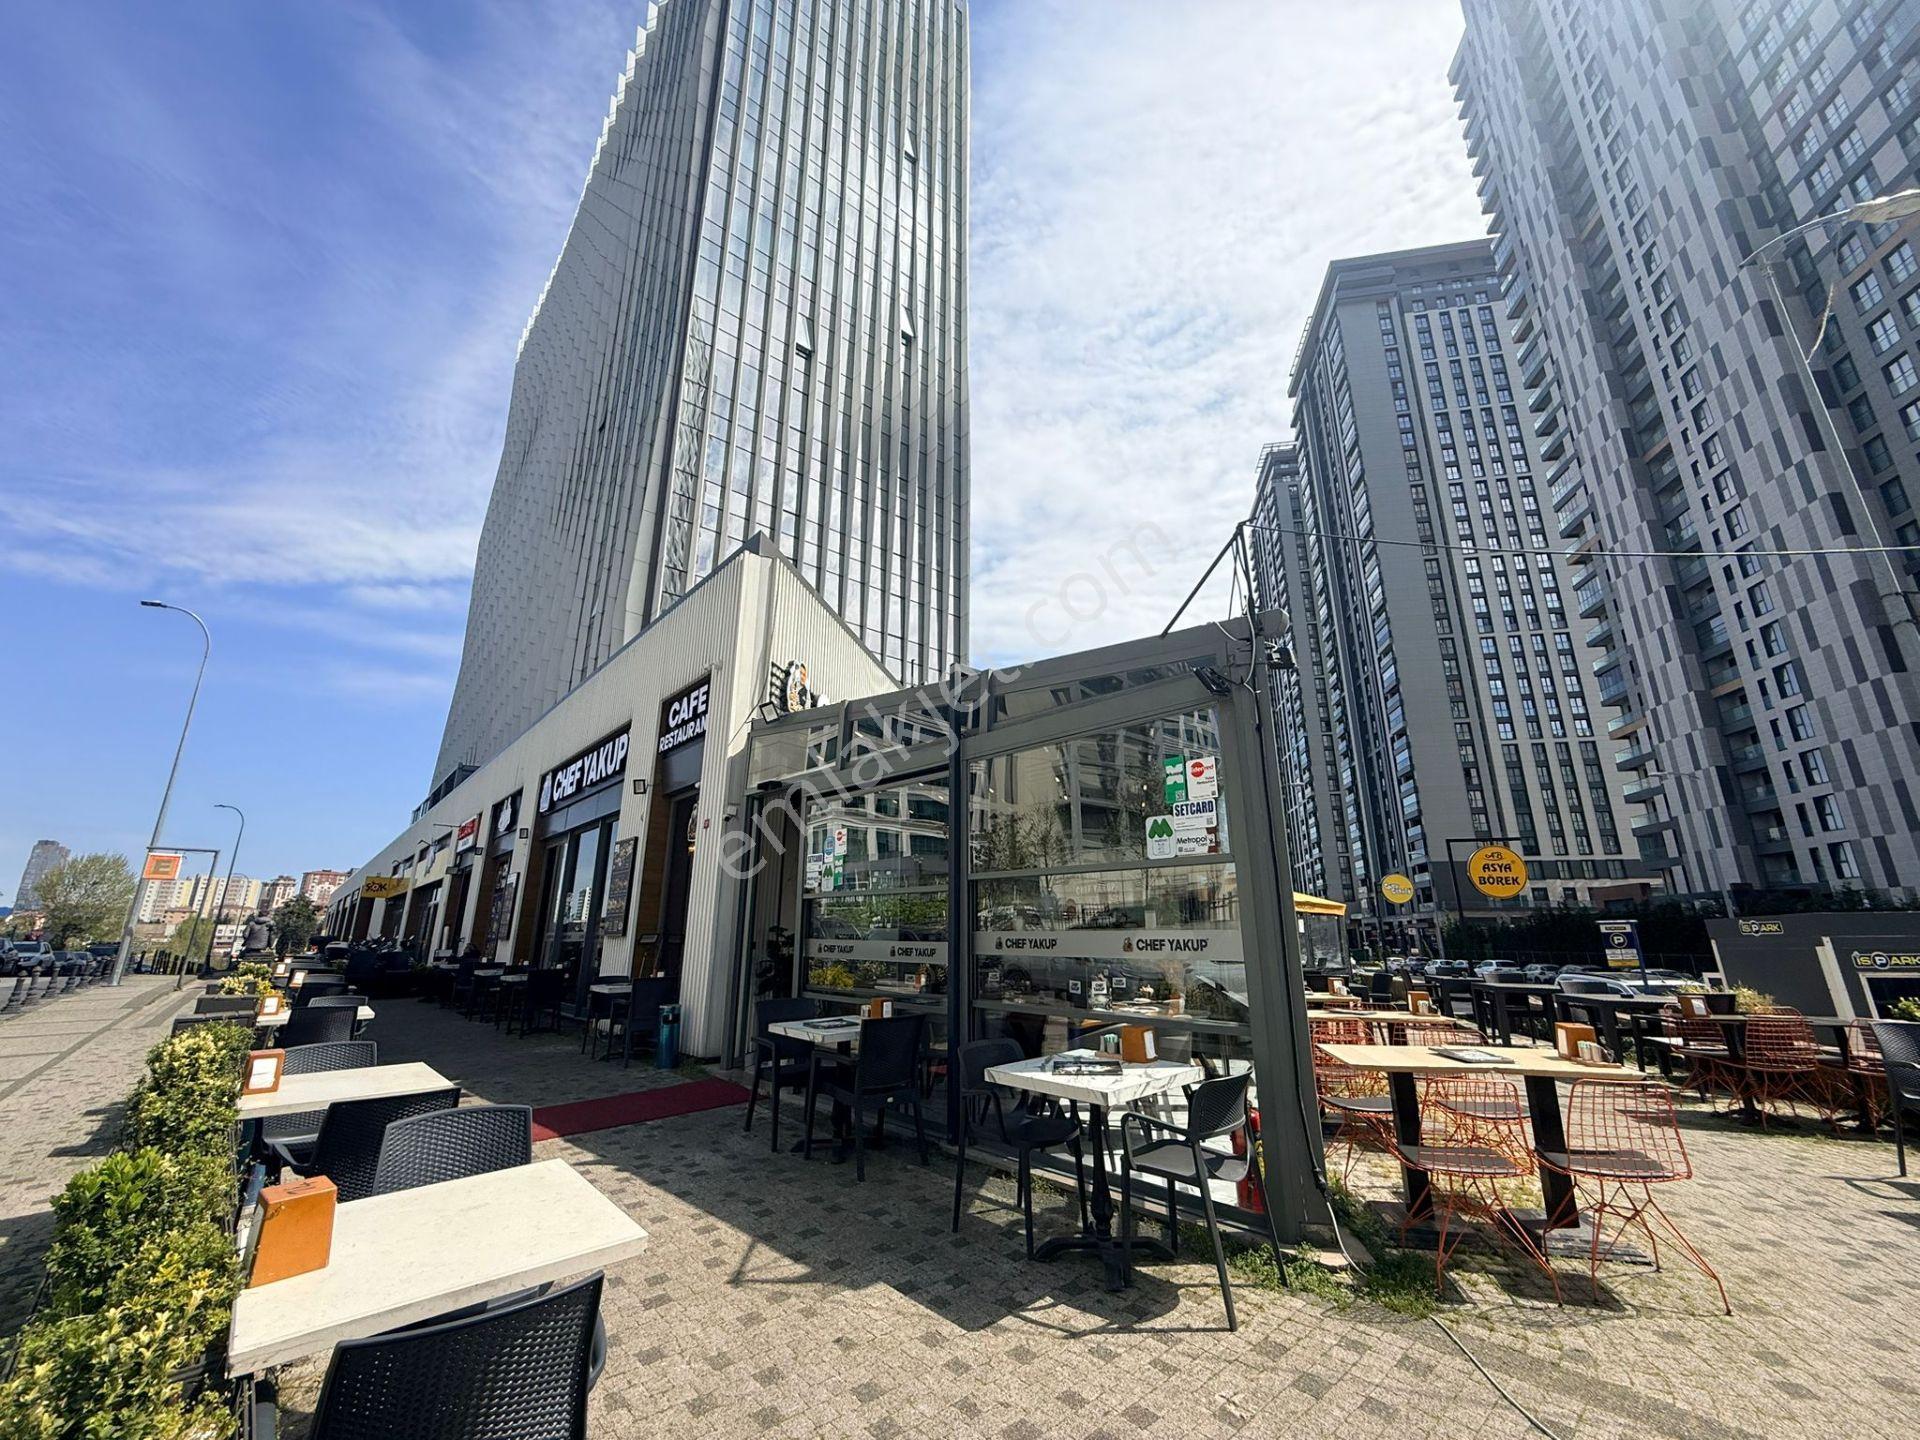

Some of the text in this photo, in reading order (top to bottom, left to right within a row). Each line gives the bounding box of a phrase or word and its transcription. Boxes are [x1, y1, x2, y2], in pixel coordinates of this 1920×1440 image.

[668, 684, 709, 728] CAFE
[553, 733, 630, 801] CHEF YAKUP
[1174, 800, 1214, 817] SETCARD
[1176, 835, 1208, 845] Metropol
[1482, 863, 1512, 873] ASYA
[1479, 874, 1521, 886] BÖREK
[823, 944, 855, 954] CHEF YAKUP
[1005, 938, 1057, 950] CHEF YAKUP
[1136, 938, 1208, 952] CHEF YAKUP
[897, 946, 937, 958] CHEF YAKUP
